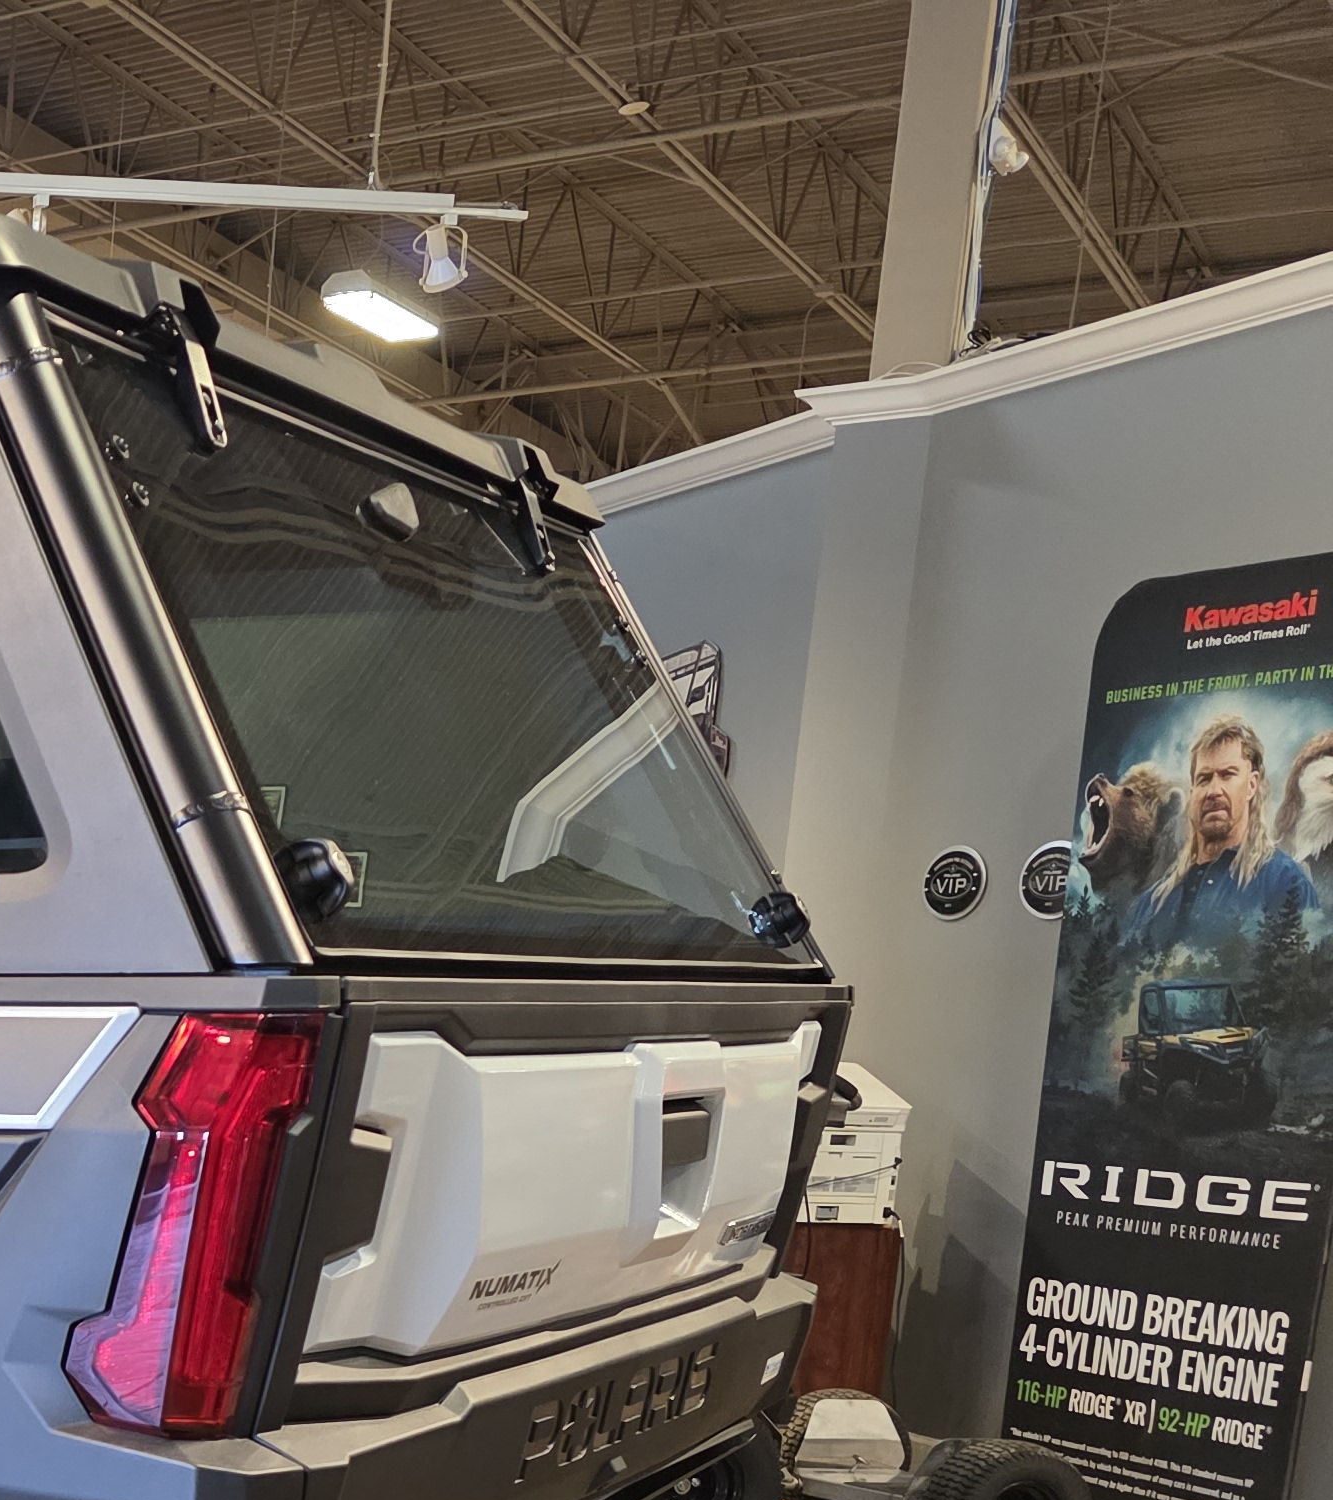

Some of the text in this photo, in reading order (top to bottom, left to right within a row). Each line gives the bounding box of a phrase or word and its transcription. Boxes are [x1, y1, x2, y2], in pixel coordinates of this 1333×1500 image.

[1184, 589, 1318, 632] Kawasaki
[1186, 638, 1202, 650] Let
[1205, 635, 1222, 647] the
[1223, 631, 1251, 645] Good
[1253, 628, 1284, 641] Times
[1106, 684, 1163, 704] BUSINESS
[1165, 681, 1179, 697] IN
[1182, 678, 1204, 695] THE
[1207, 673, 1250, 692] FRONT.
[1254, 668, 1298, 686] PARTY
[1300, 664, 1316, 681] IN
[936, 877, 967, 894] VIP
[1035, 875, 1067, 892] VIP
[1056, 1210, 1281, 1250] PEAK PREMIUM PERFORMANCE
[468, 1258, 562, 1301] NUMATIX
[1026, 1276, 1290, 1355] GROUND BREAKING
[1019, 1323, 1284, 1407] 4-CYLINDER ENGINE
[513, 1341, 719, 1484] POLARIS
[1017, 1378, 1068, 1409] 116-HP
[1123, 1399, 1147, 1427] XR
[1158, 1406, 1211, 1438] 92-HP
